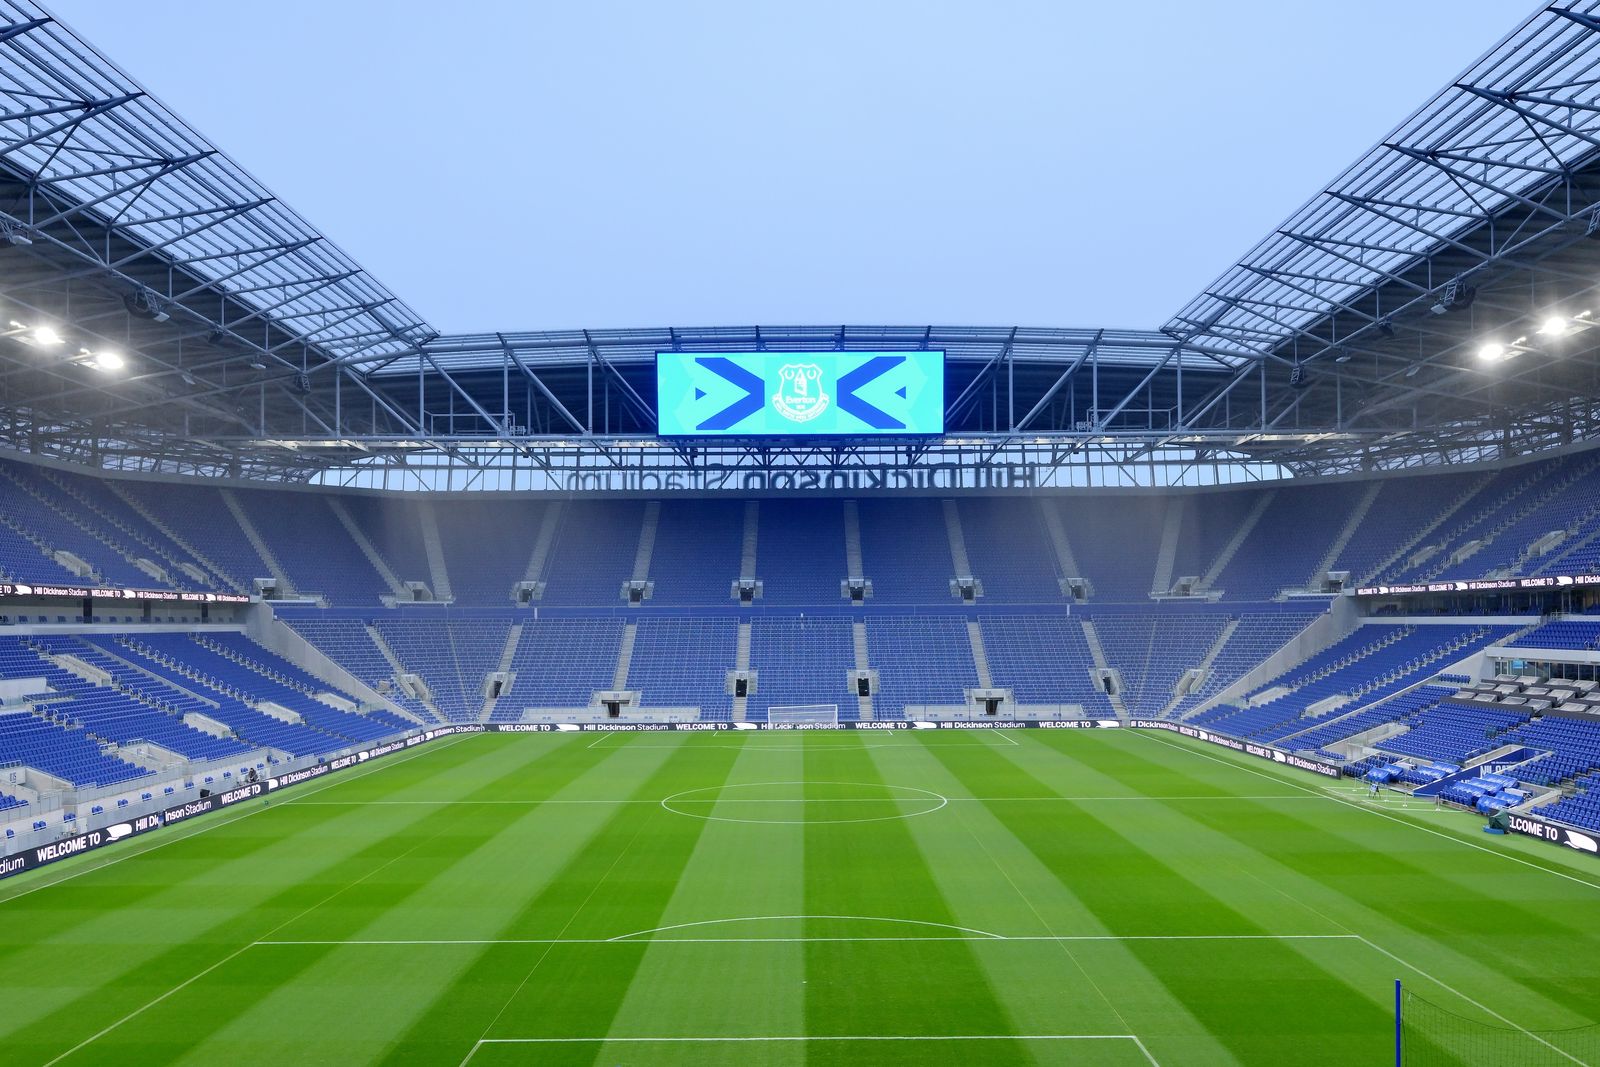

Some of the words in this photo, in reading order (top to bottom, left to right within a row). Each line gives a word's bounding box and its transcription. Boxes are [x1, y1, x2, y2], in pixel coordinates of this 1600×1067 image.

[1498, 580, 1516, 588] Stadium
[1521, 578, 1546, 587] WELCOME
[1546, 578, 1554, 586] TO
[1575, 576, 1584, 584] Hill
[4, 585, 11, 594] TO
[34, 587, 42, 595] Hill
[44, 587, 68, 596] Dickinson
[69, 588, 88, 596] Stadium
[91, 589, 114, 597] WELCOME
[498, 724, 538, 732] WELCOME
[540, 724, 550, 732] TO
[597, 723, 636, 731] Dickinson
[637, 723, 668, 731] Stadium
[954, 721, 993, 729] Dickinson
[1294, 757, 1316, 771] Dickinson
[1316, 763, 1337, 776] Stadium
[221, 788, 250, 805] WELCOME
[251, 784, 261, 794] TO
[280, 776, 288, 786] Hill
[288, 770, 311, 785] Dickinson
[311, 765, 328, 776] Stadium
[37, 839, 87, 862] WELCOME
[88, 832, 101, 846] TO
[136, 817, 148, 831] Hill
[185, 800, 212, 816] Stadium
[1544, 825, 1558, 840] TO
[0, 857, 25, 874] dium
